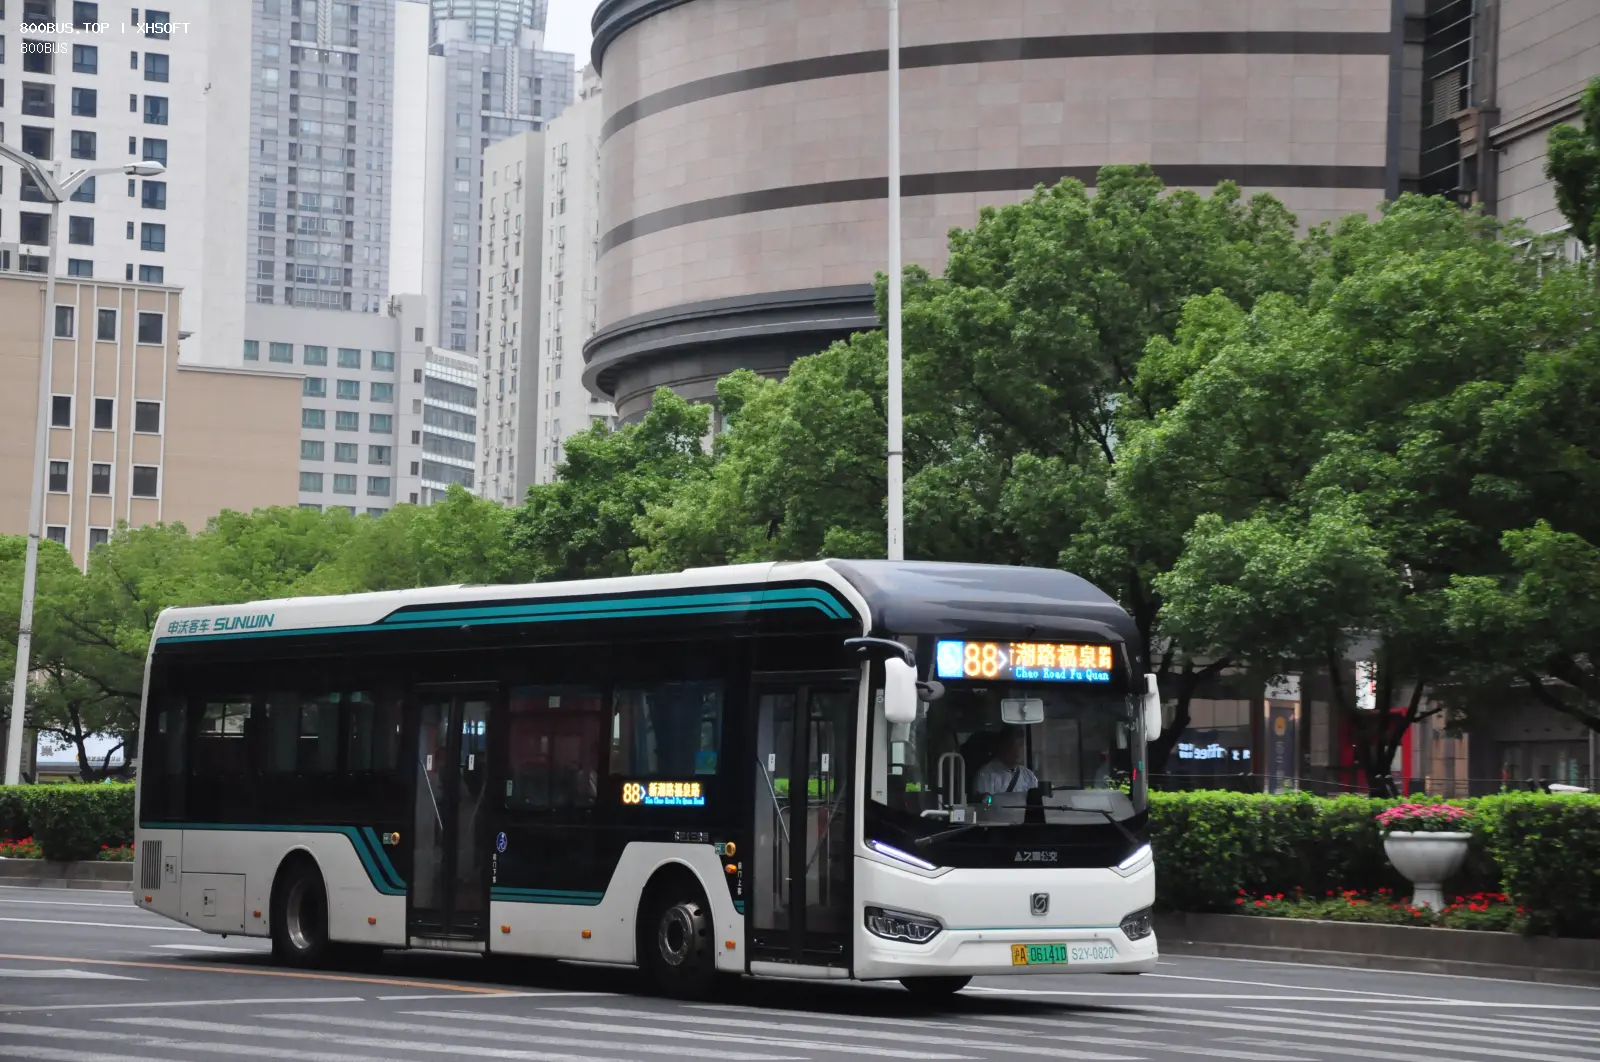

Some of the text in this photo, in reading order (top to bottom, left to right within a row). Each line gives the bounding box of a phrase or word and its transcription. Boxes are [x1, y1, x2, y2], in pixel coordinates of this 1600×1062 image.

[167, 613, 275, 634] 申沃客车 SUNWIN
[963, 642, 998, 677] 88
[1015, 667, 1110, 682] Chao Road Fu Quan
[622, 782, 640, 804] 88
[1071, 945, 1115, 961] S2Y-0820
